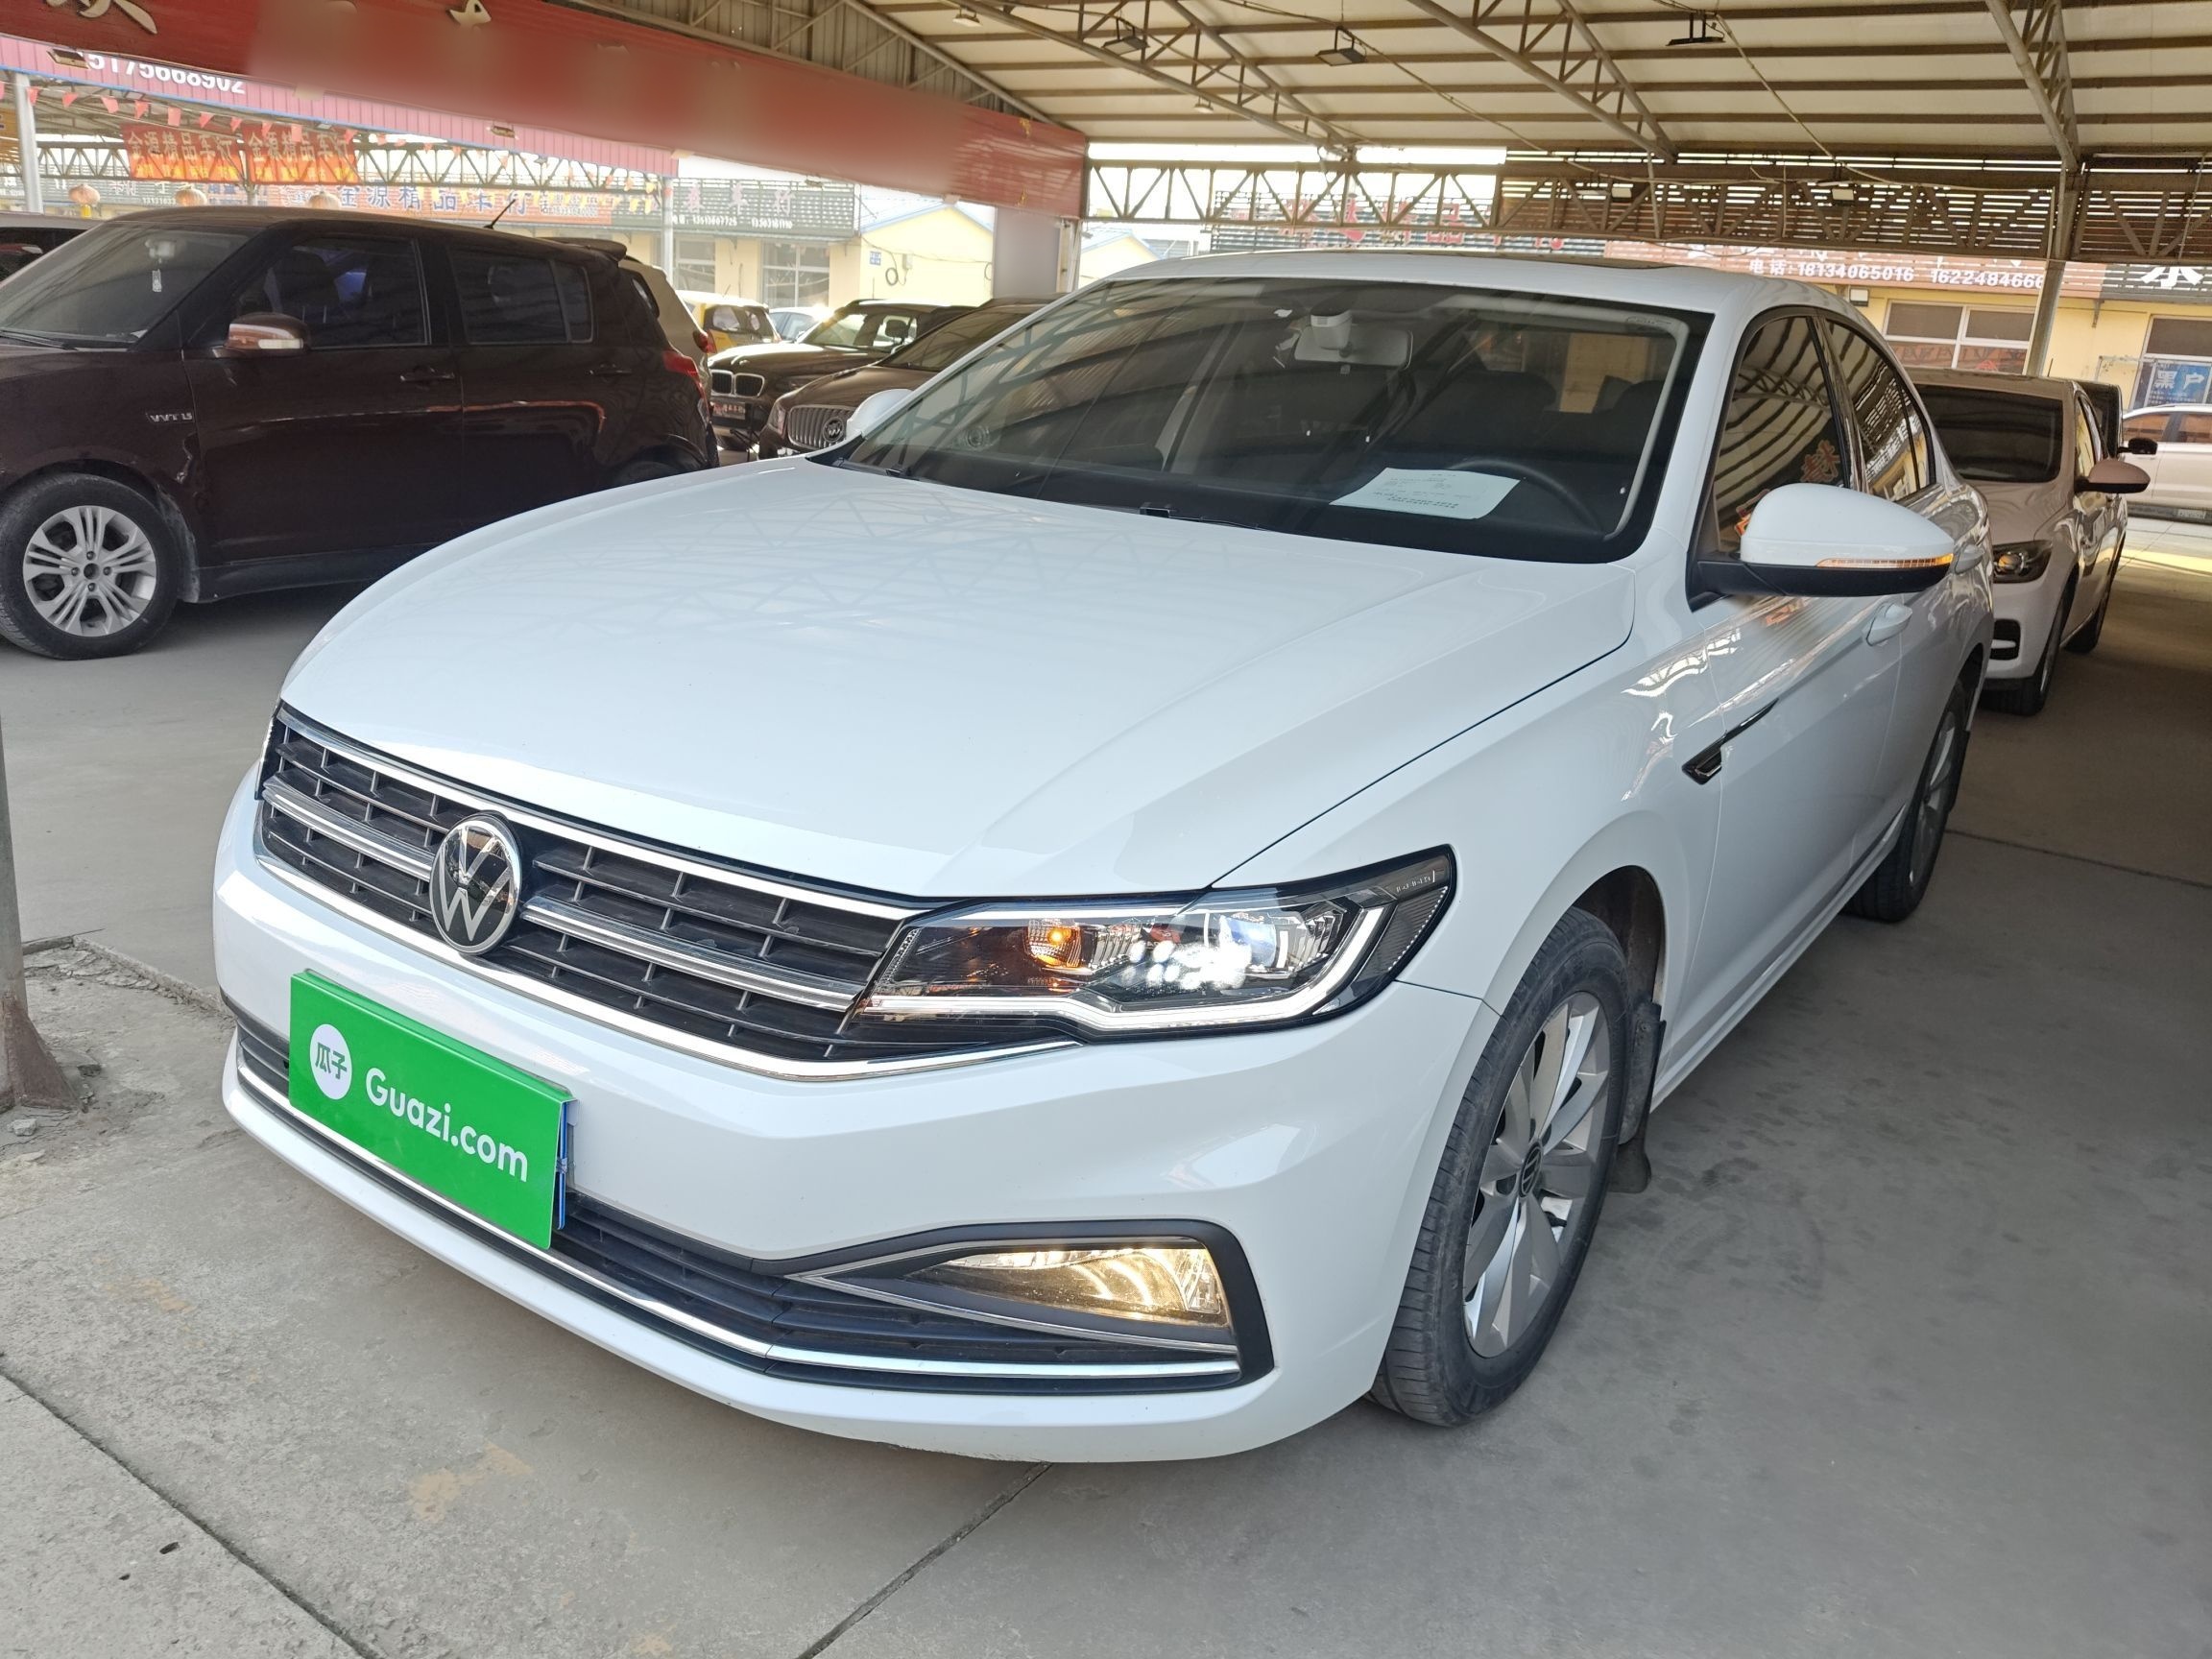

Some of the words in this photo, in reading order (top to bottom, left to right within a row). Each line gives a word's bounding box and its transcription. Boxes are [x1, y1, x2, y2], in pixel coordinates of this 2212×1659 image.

[1798, 261, 1914, 282] 18134065016
[315, 1041, 348, 1081] 瓜子
[365, 1067, 528, 1183] Guazi.com
